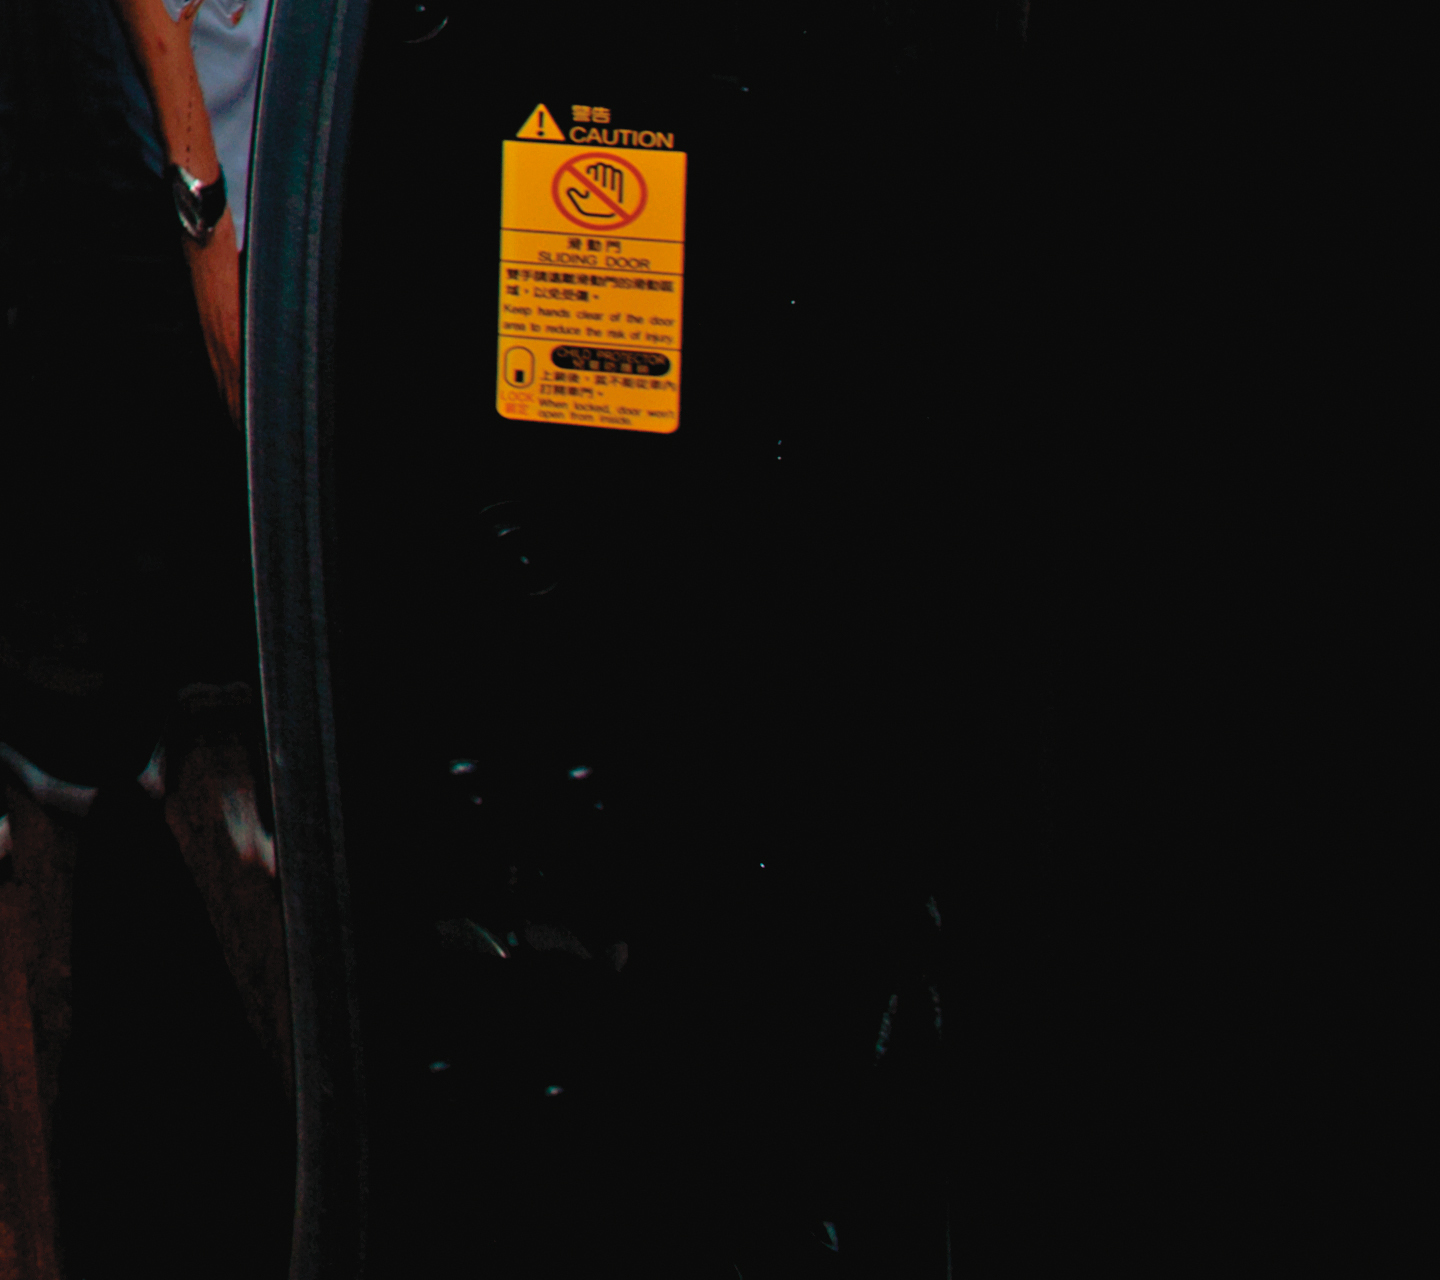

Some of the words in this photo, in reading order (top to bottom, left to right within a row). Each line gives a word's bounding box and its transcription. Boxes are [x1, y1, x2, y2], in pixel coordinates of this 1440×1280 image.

[571, 104, 611, 124] 警告
[569, 126, 675, 149] CAUTION
[537, 251, 598, 266] SLIDING
[605, 255, 651, 270] DOOR
[503, 303, 532, 316] Keep
[537, 306, 570, 318] hands
[626, 313, 644, 324] the
[648, 315, 675, 326] door
[530, 322, 541, 332] to
